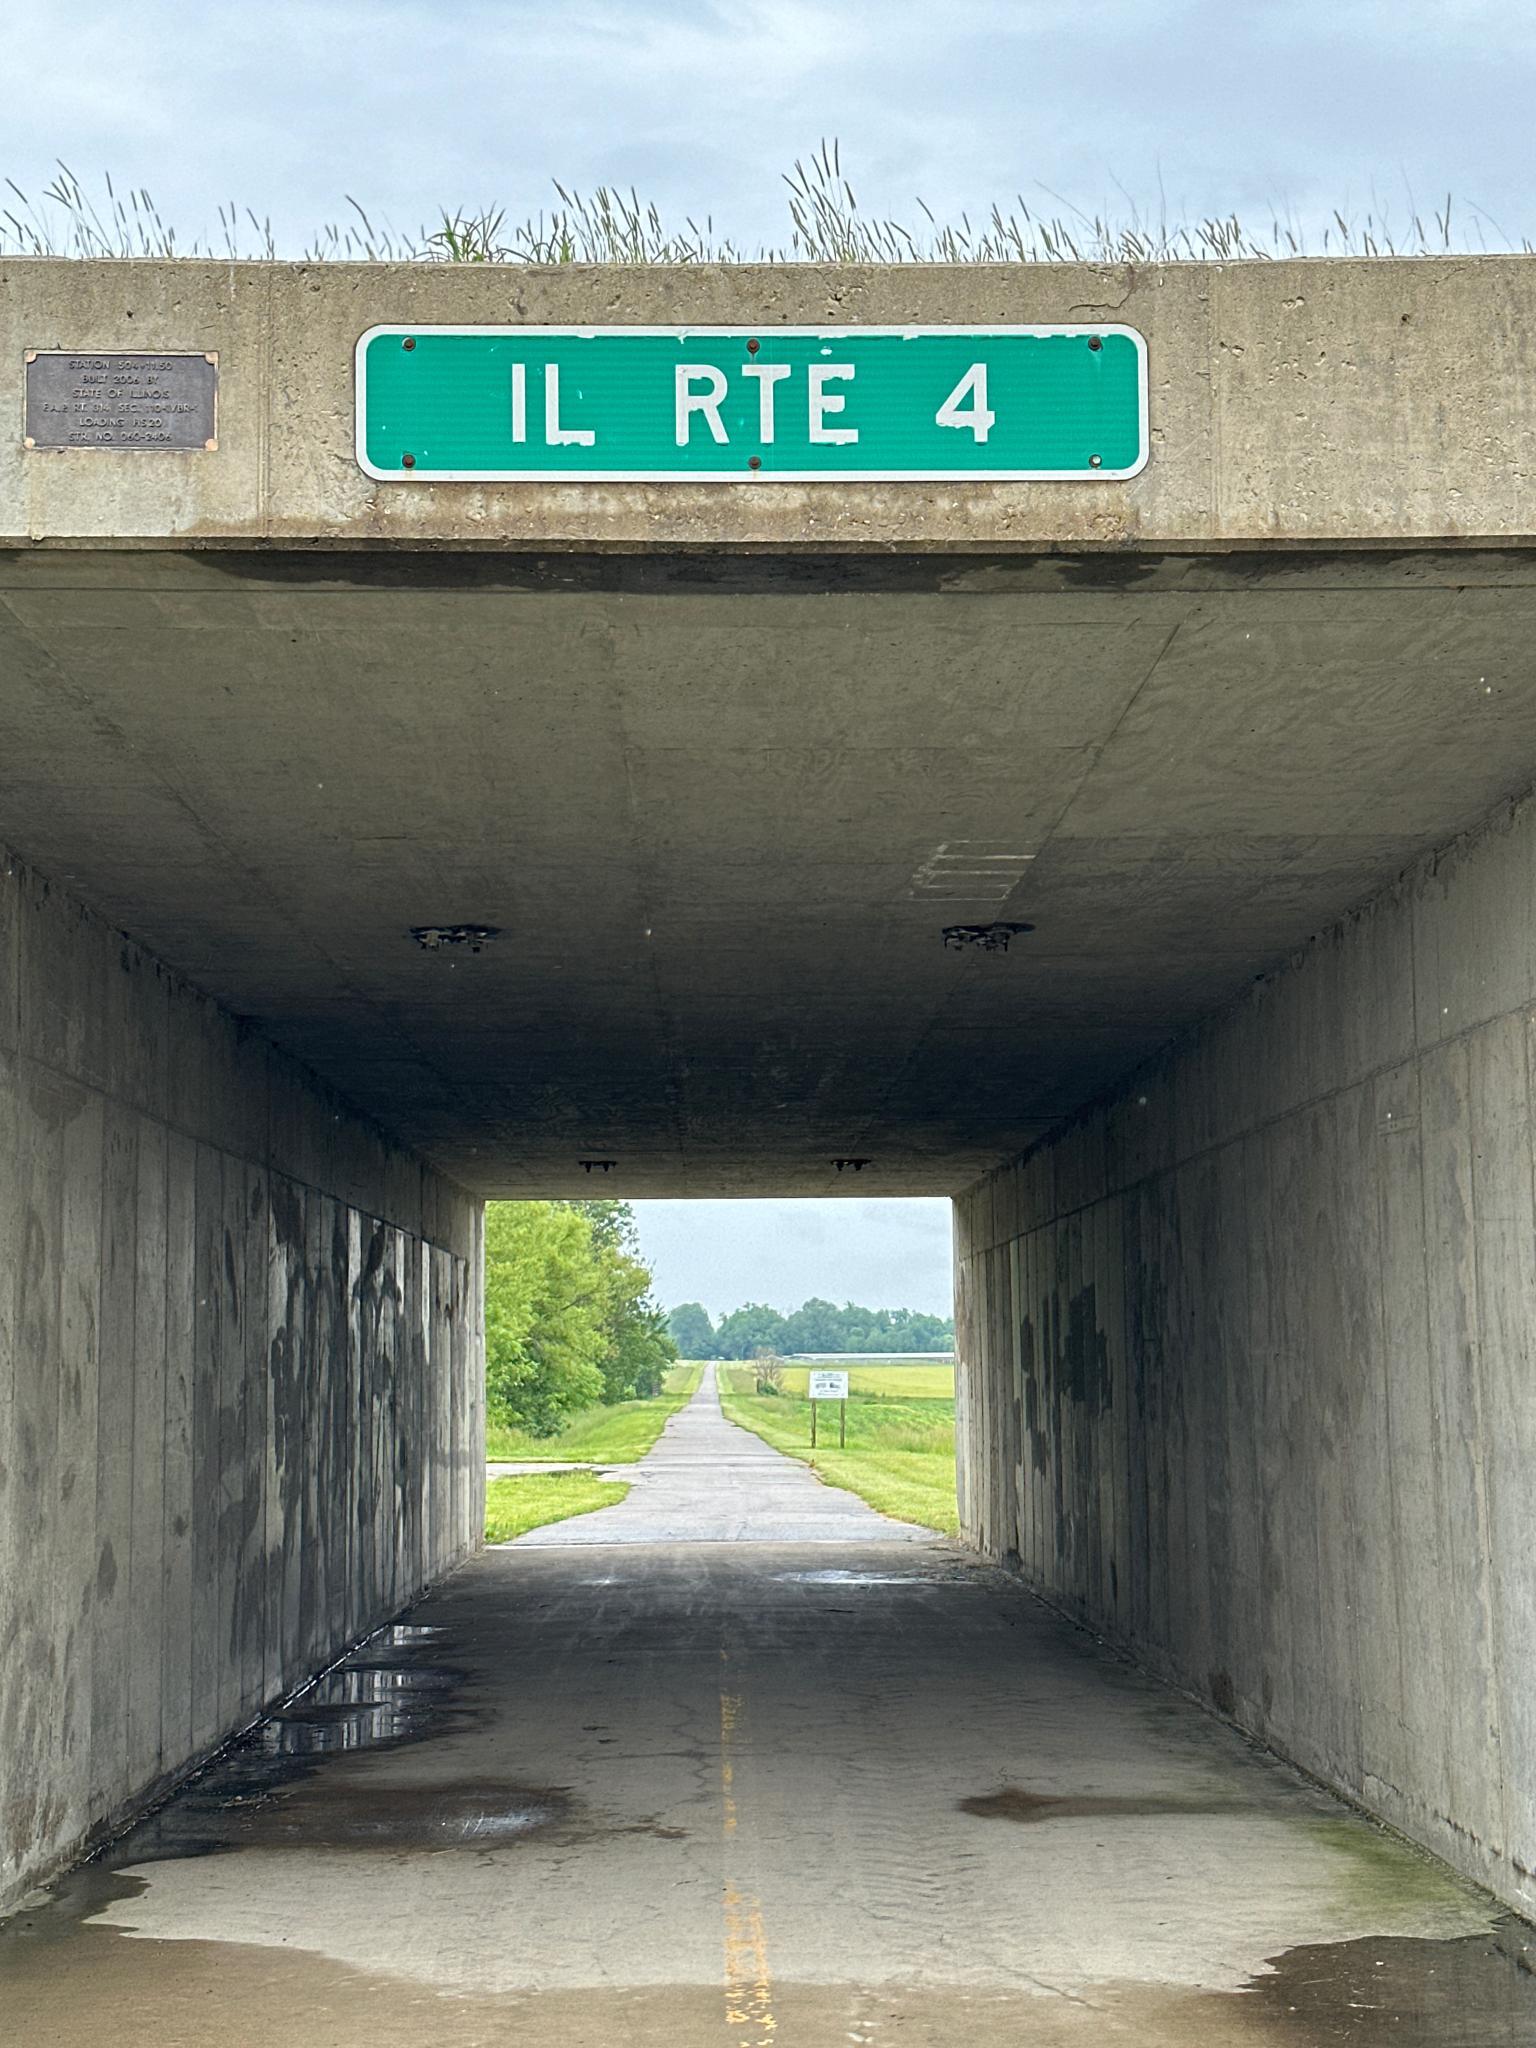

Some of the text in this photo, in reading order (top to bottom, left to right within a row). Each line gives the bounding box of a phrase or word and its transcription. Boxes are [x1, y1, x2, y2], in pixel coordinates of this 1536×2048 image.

[68, 360, 110, 370] STATION
[81, 374, 160, 385] BUILT 2006 BY
[72, 388, 171, 399] STATE OF ILLINOIS
[511, 362, 996, 447] IL RTE 4
[79, 416, 163, 428] LOADING HS20
